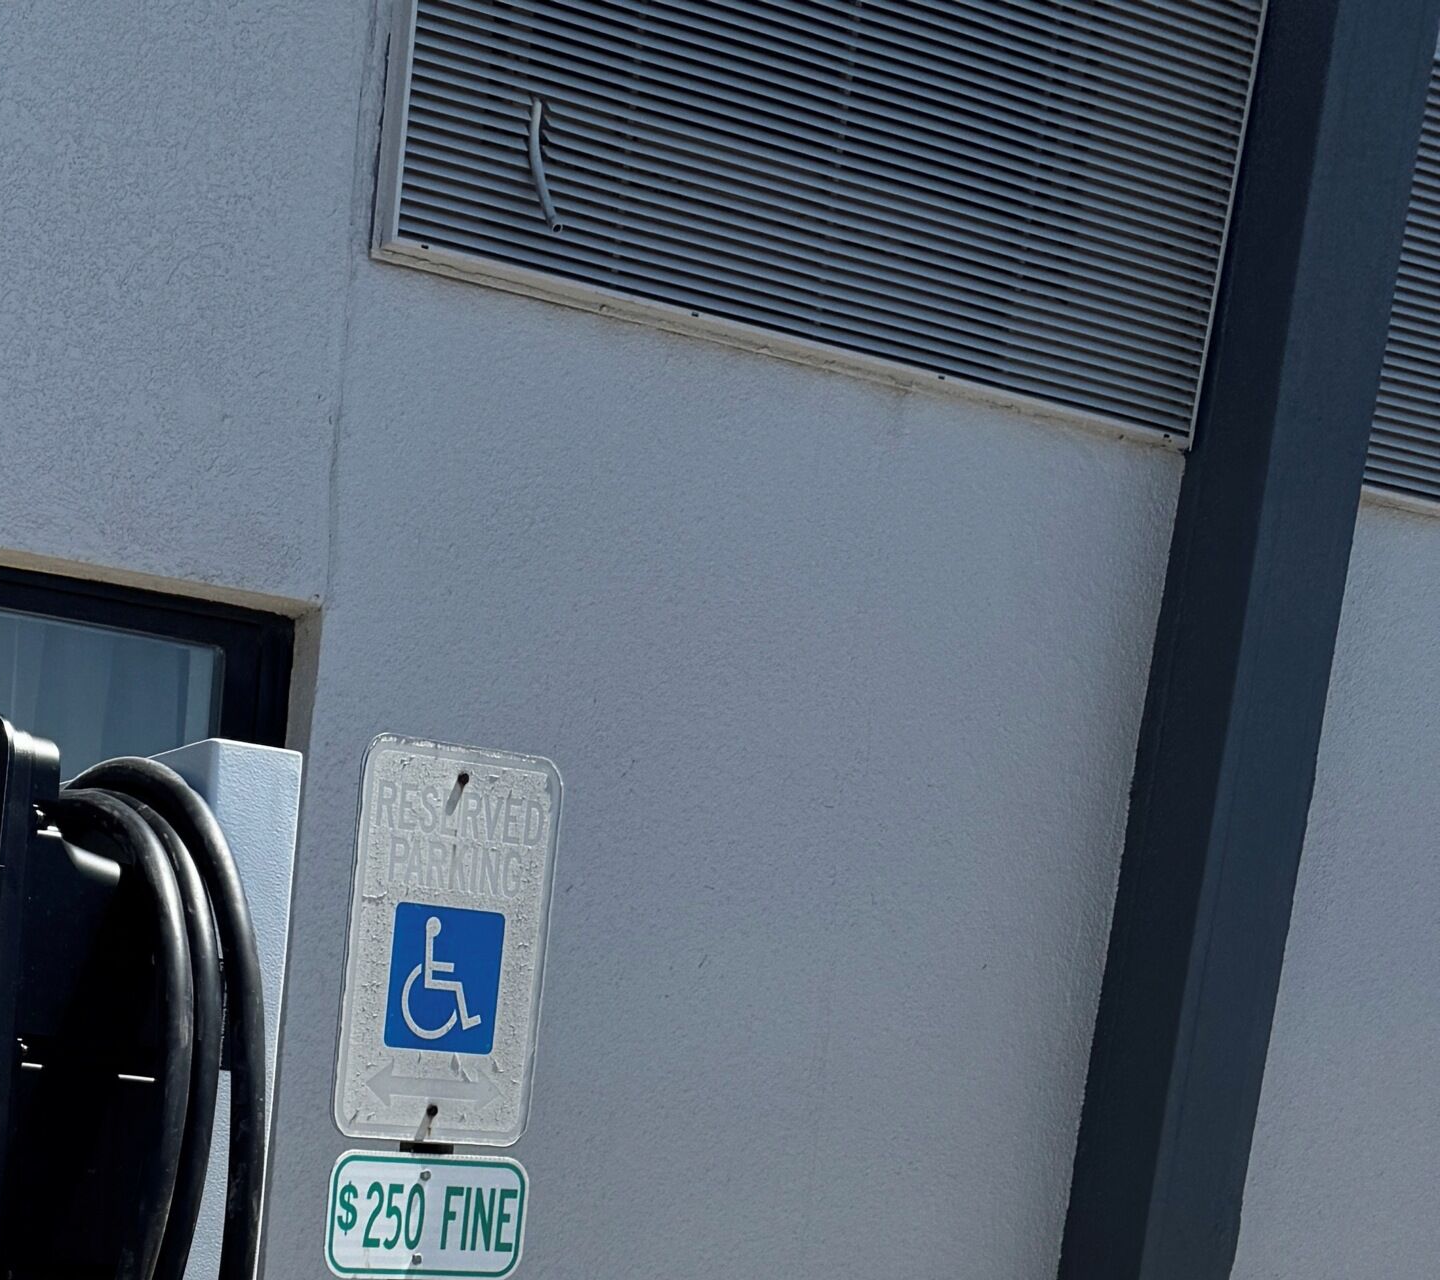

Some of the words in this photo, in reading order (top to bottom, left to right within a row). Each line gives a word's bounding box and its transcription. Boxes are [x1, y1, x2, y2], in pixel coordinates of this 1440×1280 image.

[375, 779, 545, 847] RESERVED
[388, 834, 522, 898] PARKING
[337, 1181, 425, 1250] $250
[440, 1186, 518, 1252] FINE
